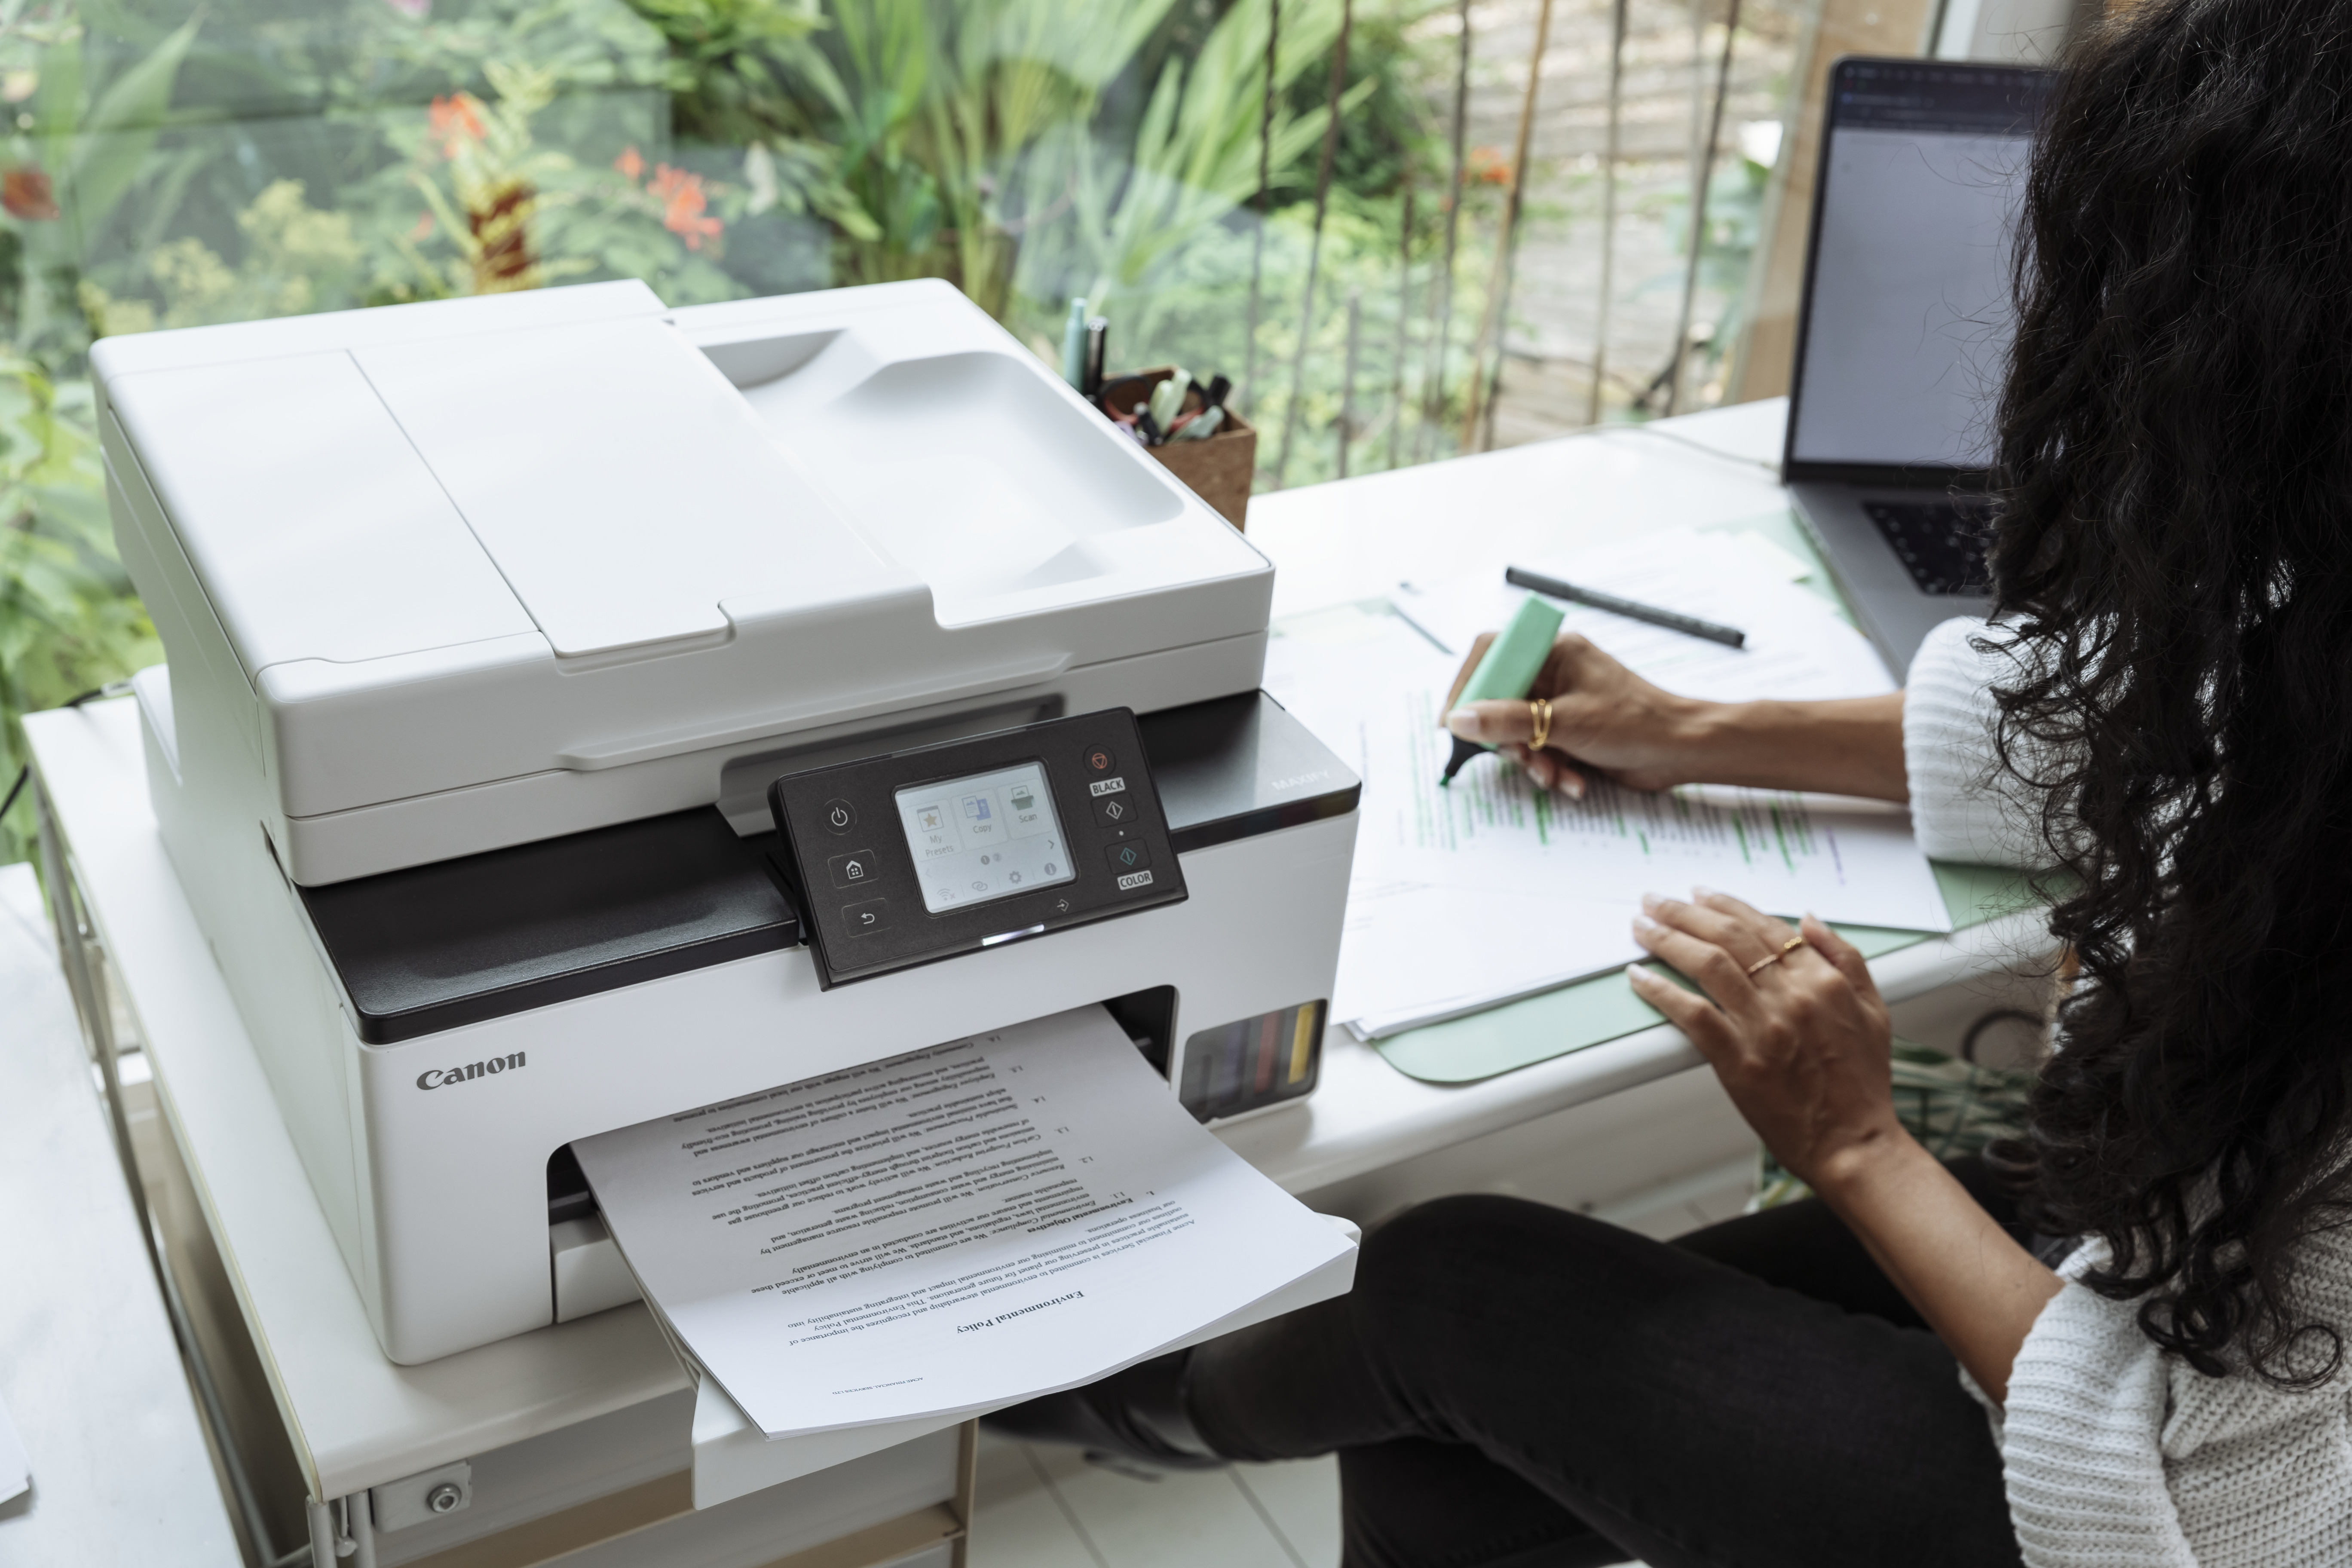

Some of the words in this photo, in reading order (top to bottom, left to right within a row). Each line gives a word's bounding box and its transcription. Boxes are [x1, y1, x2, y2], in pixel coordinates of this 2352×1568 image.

[1092, 779, 1123, 794] BLACK
[1019, 814, 1038, 823] Scan
[973, 824, 992, 834] Copy
[929, 834, 942, 844] My
[925, 845, 953, 857] Presets
[1120, 872, 1151, 888] COLOR
[416, 1051, 526, 1090] Canon
[1033, 1178, 1078, 1194] responsible
[942, 1194, 959, 1203] will
[1001, 1191, 1033, 1203] manner.
[1033, 1185, 1084, 1203] requirements
[908, 1197, 942, 1212] promote
[990, 1205, 1017, 1216] ensure
[1017, 1200, 1033, 1209] and
[1034, 1193, 1090, 1213] environmental
[1071, 1197, 1133, 1220] Environmental
[861, 1209, 907, 1225] responsible
[1011, 1209, 1035, 1218] laws,
[1040, 1200, 1096, 1222] Environmental
[1128, 1206, 1163, 1219] business
[1151, 1207, 1182, 1220] outlines
[825, 1222, 861, 1235] resource
[938, 1217, 975, 1231] activities
[965, 1216, 1012, 1231] regulations,
[989, 1217, 1038, 1235] Compliance:
[1026, 1217, 1071, 1233] Objectives
[1084, 1217, 1127, 1233] operations.
[1146, 1213, 1189, 1231] sustainable
[1172, 1219, 1194, 1230] Acme
[881, 1232, 923, 1249] conducted
[949, 1230, 965, 1238] and
[1087, 1223, 1136, 1243] commitment
[1111, 1228, 1146, 1243] practices
[1135, 1228, 1173, 1246] Financial
[771, 1232, 825, 1251] management
[907, 1234, 948, 1249] standards.
[1100, 1242, 1135, 1256] Services
[874, 1252, 891, 1260] will
[914, 1241, 958, 1258] committed
[1030, 1243, 1077, 1259] minimising
[1057, 1243, 1101, 1261] preserving
[792, 1251, 858, 1274] environmentally
[849, 1256, 873, 1266] strive
[858, 1257, 903, 1273] complying
[1017, 1262, 1043, 1274] planet
[1048, 1257, 1091, 1275] committed
[816, 1267, 838, 1276] meet
[838, 1271, 858, 1279] with
[957, 1262, 1015, 1283] environmental
[774, 1276, 804, 1288] exceed
[781, 1279, 825, 1294] applicable
[927, 1280, 957, 1291] impact
[977, 1275, 1003, 1286] future
[980, 1274, 1038, 1296] environmental
[751, 1284, 774, 1293] these
[910, 1288, 927, 1297] and
[926, 1282, 976, 1300] generations.
[863, 1293, 910, 1309] integrating
[929, 1292, 978, 1310] stewardship
[995, 1290, 1084, 1323] Environmental
[807, 1306, 863, 1324] sustainability
[842, 1304, 906, 1325] Environmental
[912, 1307, 928, 1316] and
[814, 1321, 842, 1331] Policy
[865, 1312, 911, 1327] recognizes
[957, 1319, 994, 1333] Policy
[800, 1328, 849, 1342] importance
[872, 1380, 906, 1389] FINANCIAL
